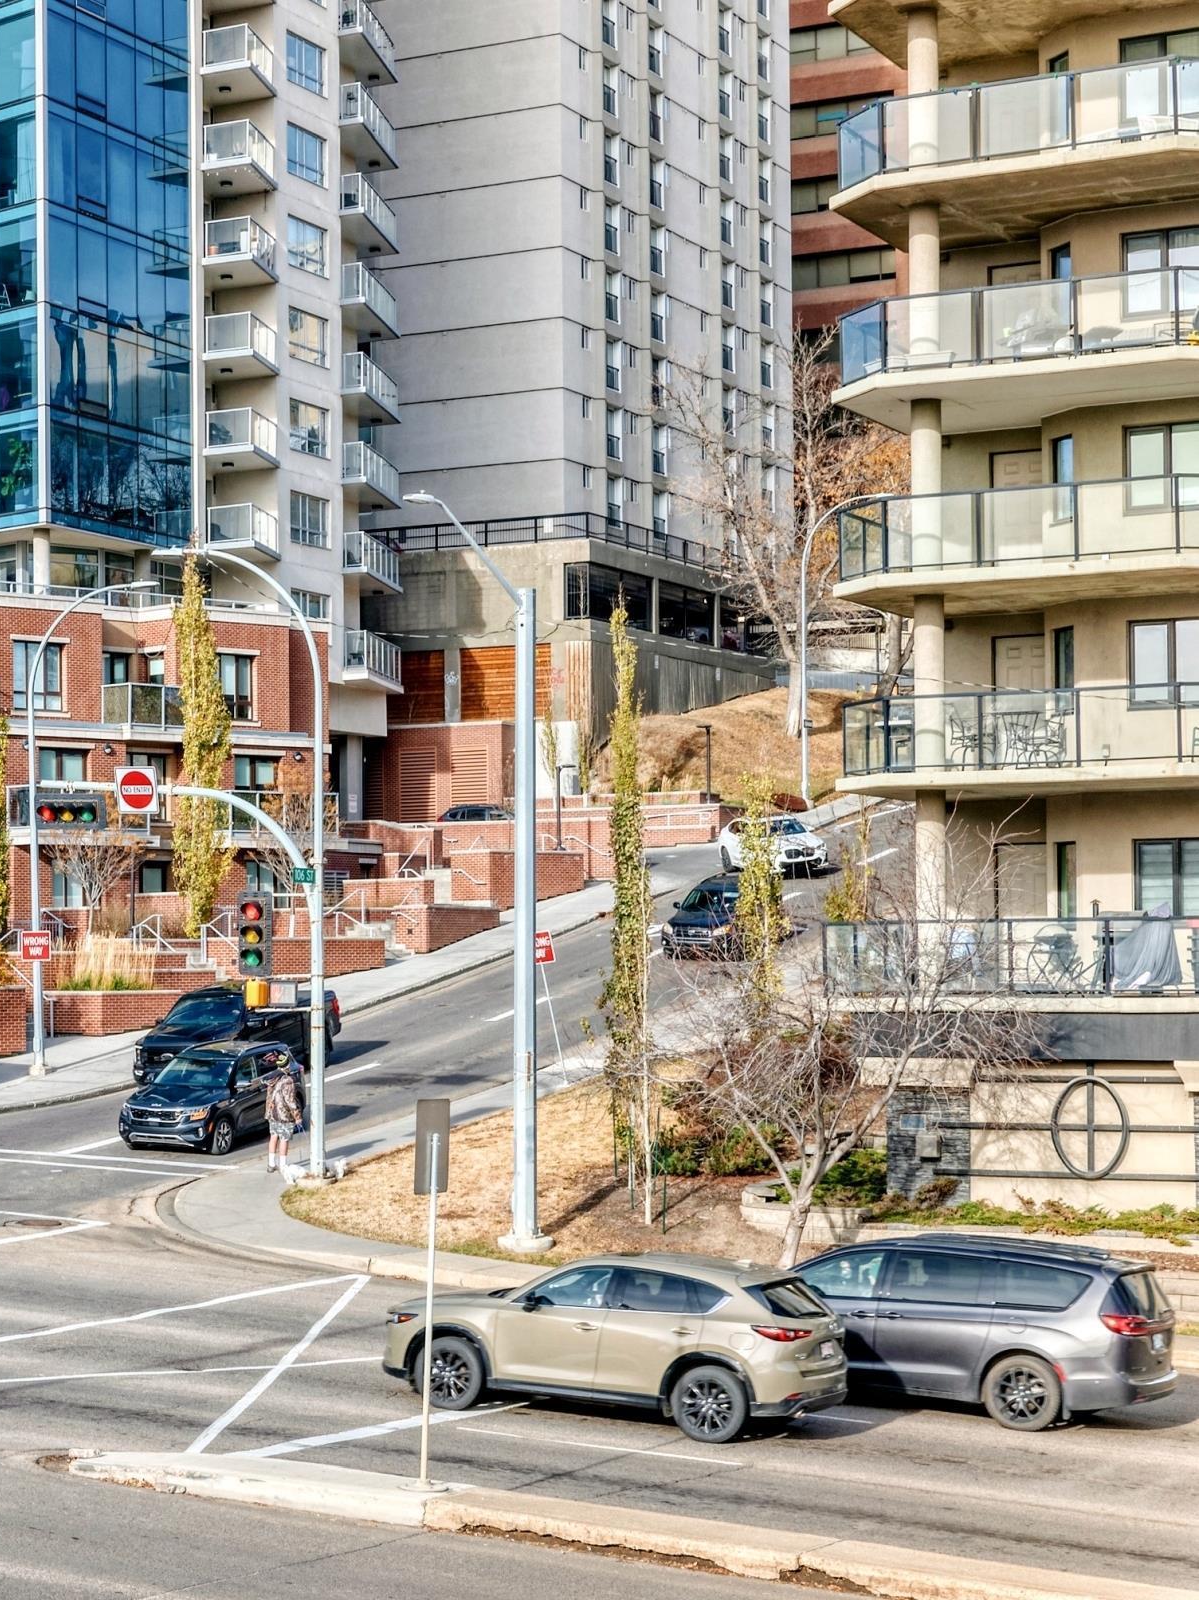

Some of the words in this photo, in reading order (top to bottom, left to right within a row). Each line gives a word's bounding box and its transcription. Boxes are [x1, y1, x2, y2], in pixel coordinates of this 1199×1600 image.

[294, 869, 305, 881] 106
[306, 870, 314, 881] ST
[23, 936, 49, 946] WRONG
[535, 936, 550, 947] ONG
[29, 946, 43, 957] WAY
